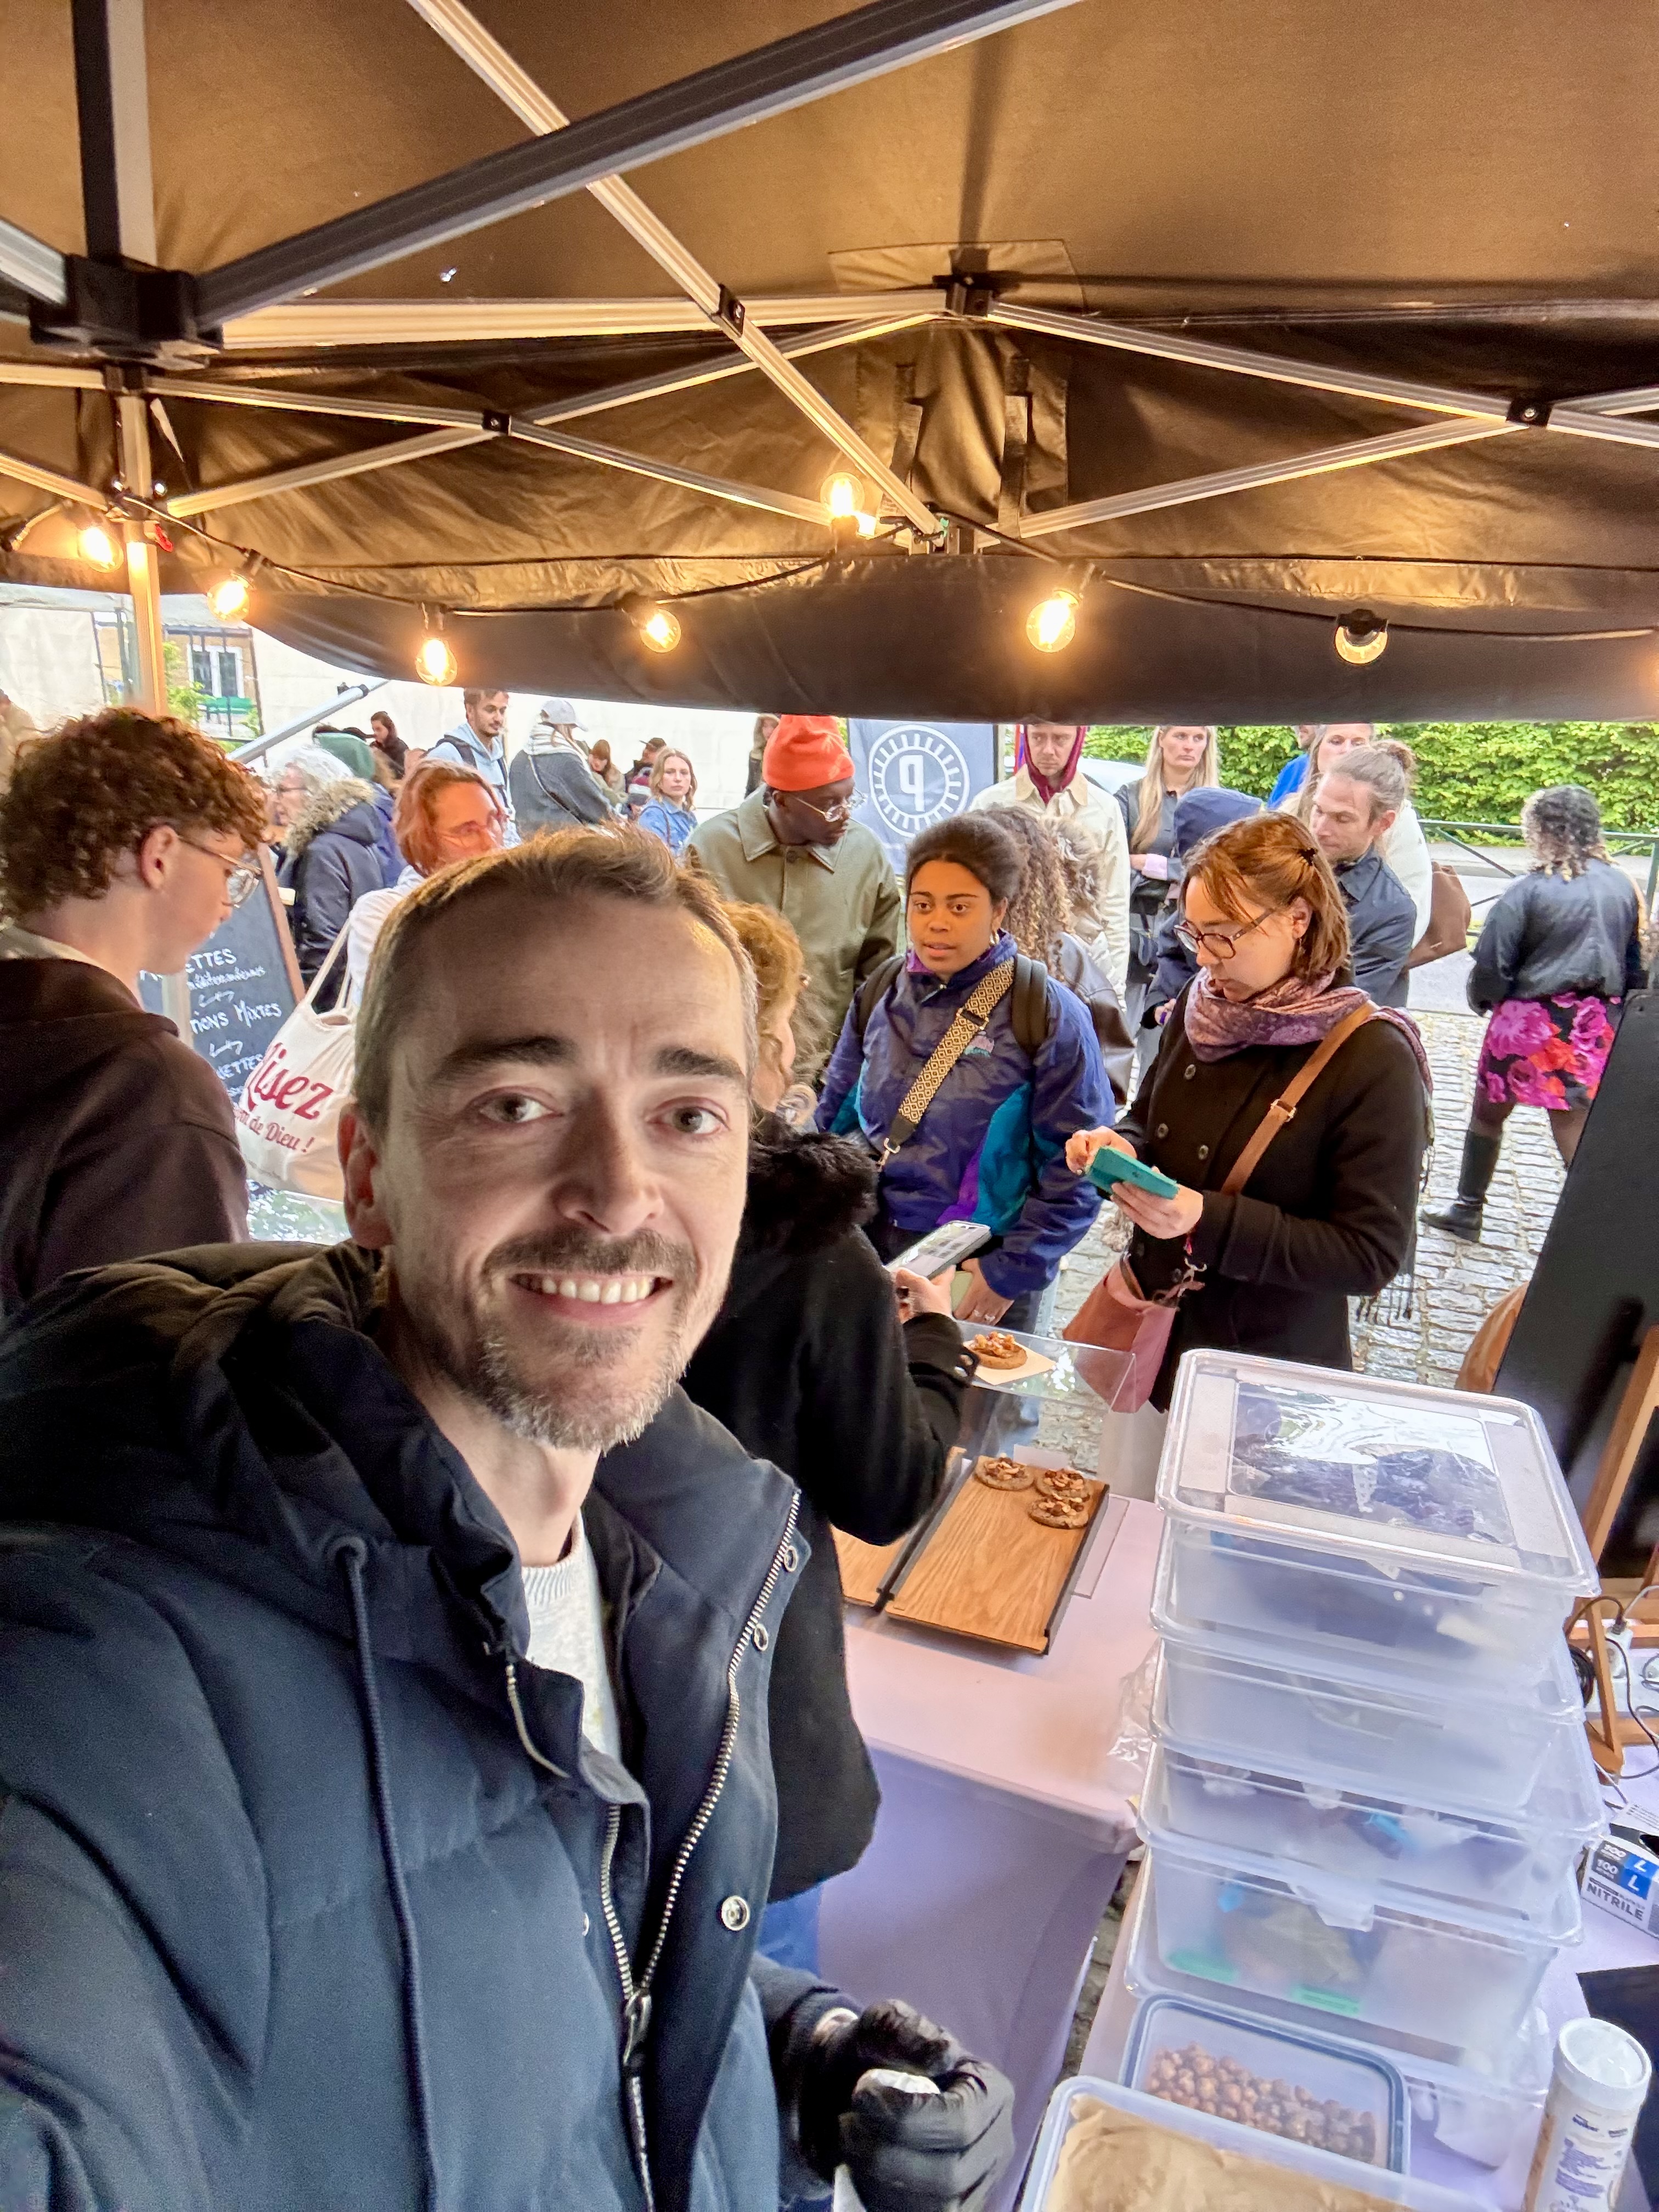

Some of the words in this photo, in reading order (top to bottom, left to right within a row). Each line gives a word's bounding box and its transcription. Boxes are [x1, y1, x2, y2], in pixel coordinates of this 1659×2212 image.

[266, 1122, 300, 1150] Dieu
[1597, 1858, 1618, 1875] 100
[1633, 1859, 1647, 1872] L
[1627, 1874, 1640, 1892] L
[1586, 1882, 1645, 1921] NITRILE
